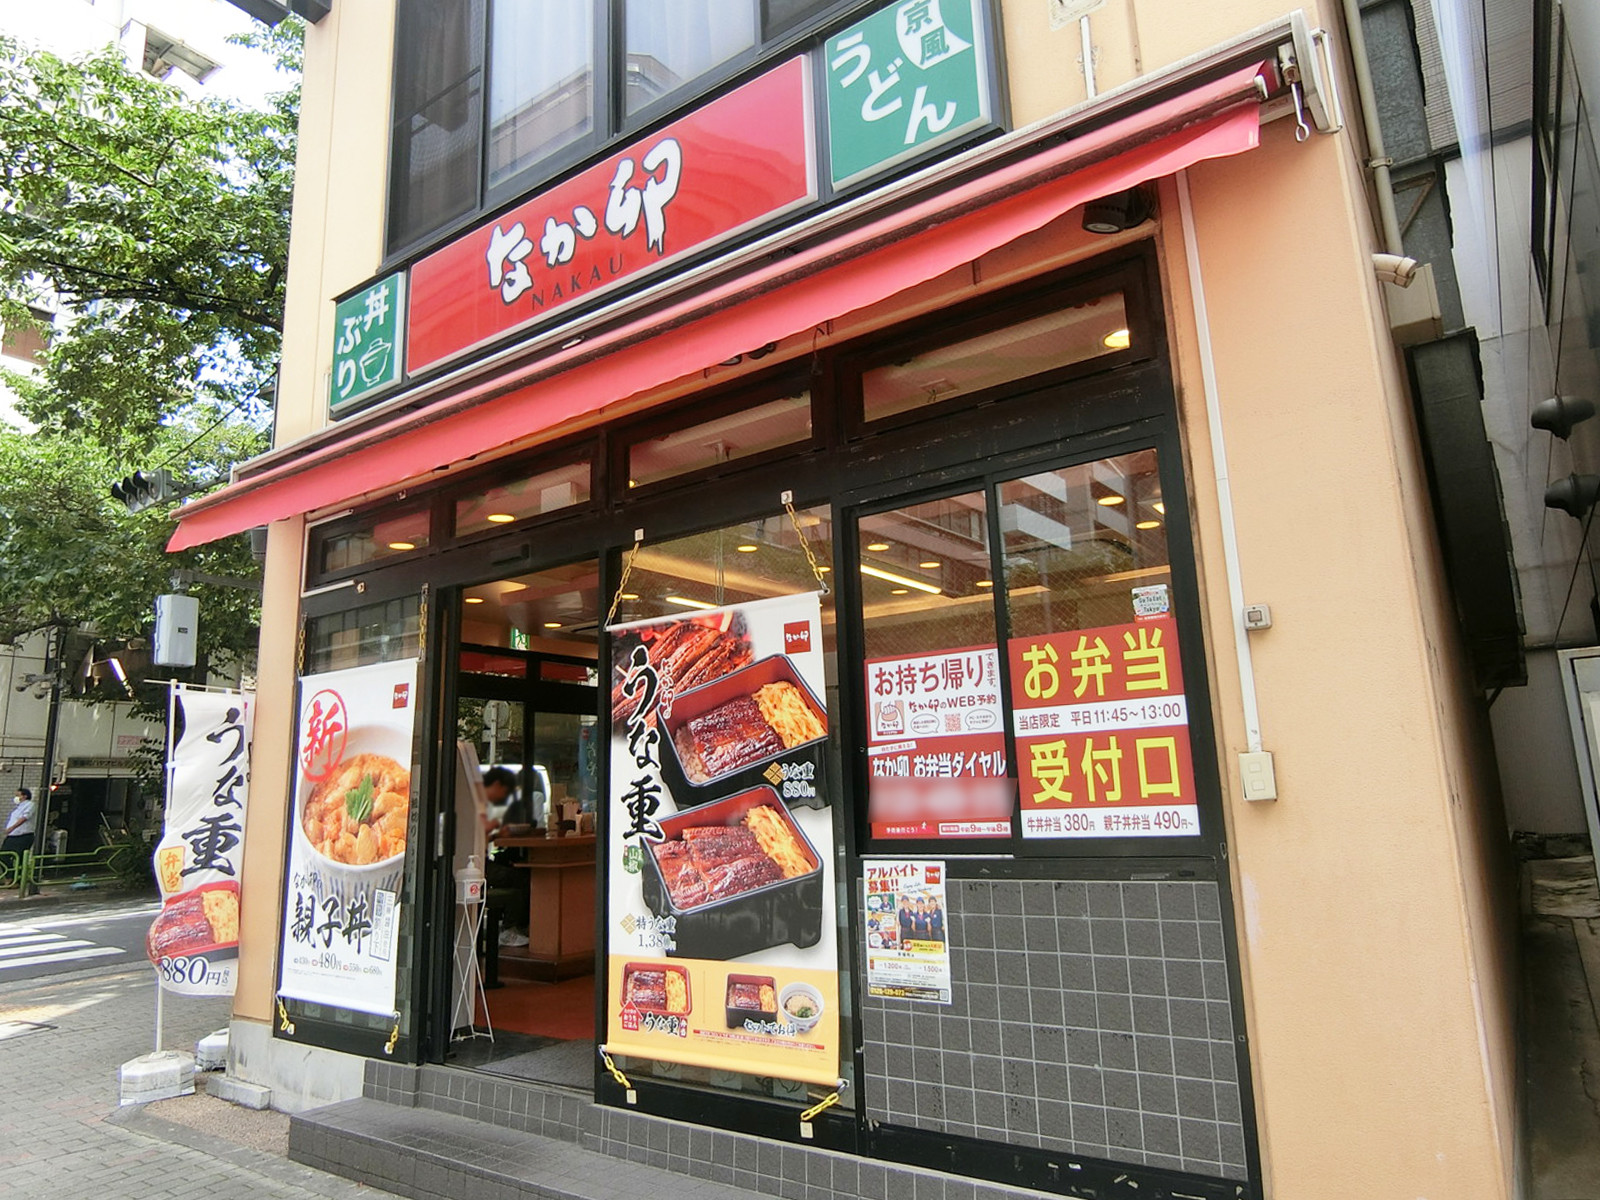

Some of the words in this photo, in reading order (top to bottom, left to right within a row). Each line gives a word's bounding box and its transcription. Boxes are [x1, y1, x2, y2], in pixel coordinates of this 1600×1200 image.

[903, 0, 950, 65] 京風
[831, 31, 957, 145] うどん
[486, 138, 682, 306] なか卯
[532, 253, 624, 311] NAKAU
[785, 630, 809, 643] なか卯
[1022, 627, 1169, 699] お弁当
[874, 655, 984, 696] お持ち帰り
[303, 700, 343, 771] 新
[621, 646, 666, 843] うな重
[1019, 713, 1060, 730] 当店限定
[180, 707, 244, 877] うな重
[782, 761, 815, 781] うな重
[1030, 736, 1181, 804] 受付口
[164, 852, 180, 888] 弁当
[867, 864, 918, 879] アルバイト
[291, 891, 371, 955] 親子丼
[644, 1012, 679, 1036] うな重
